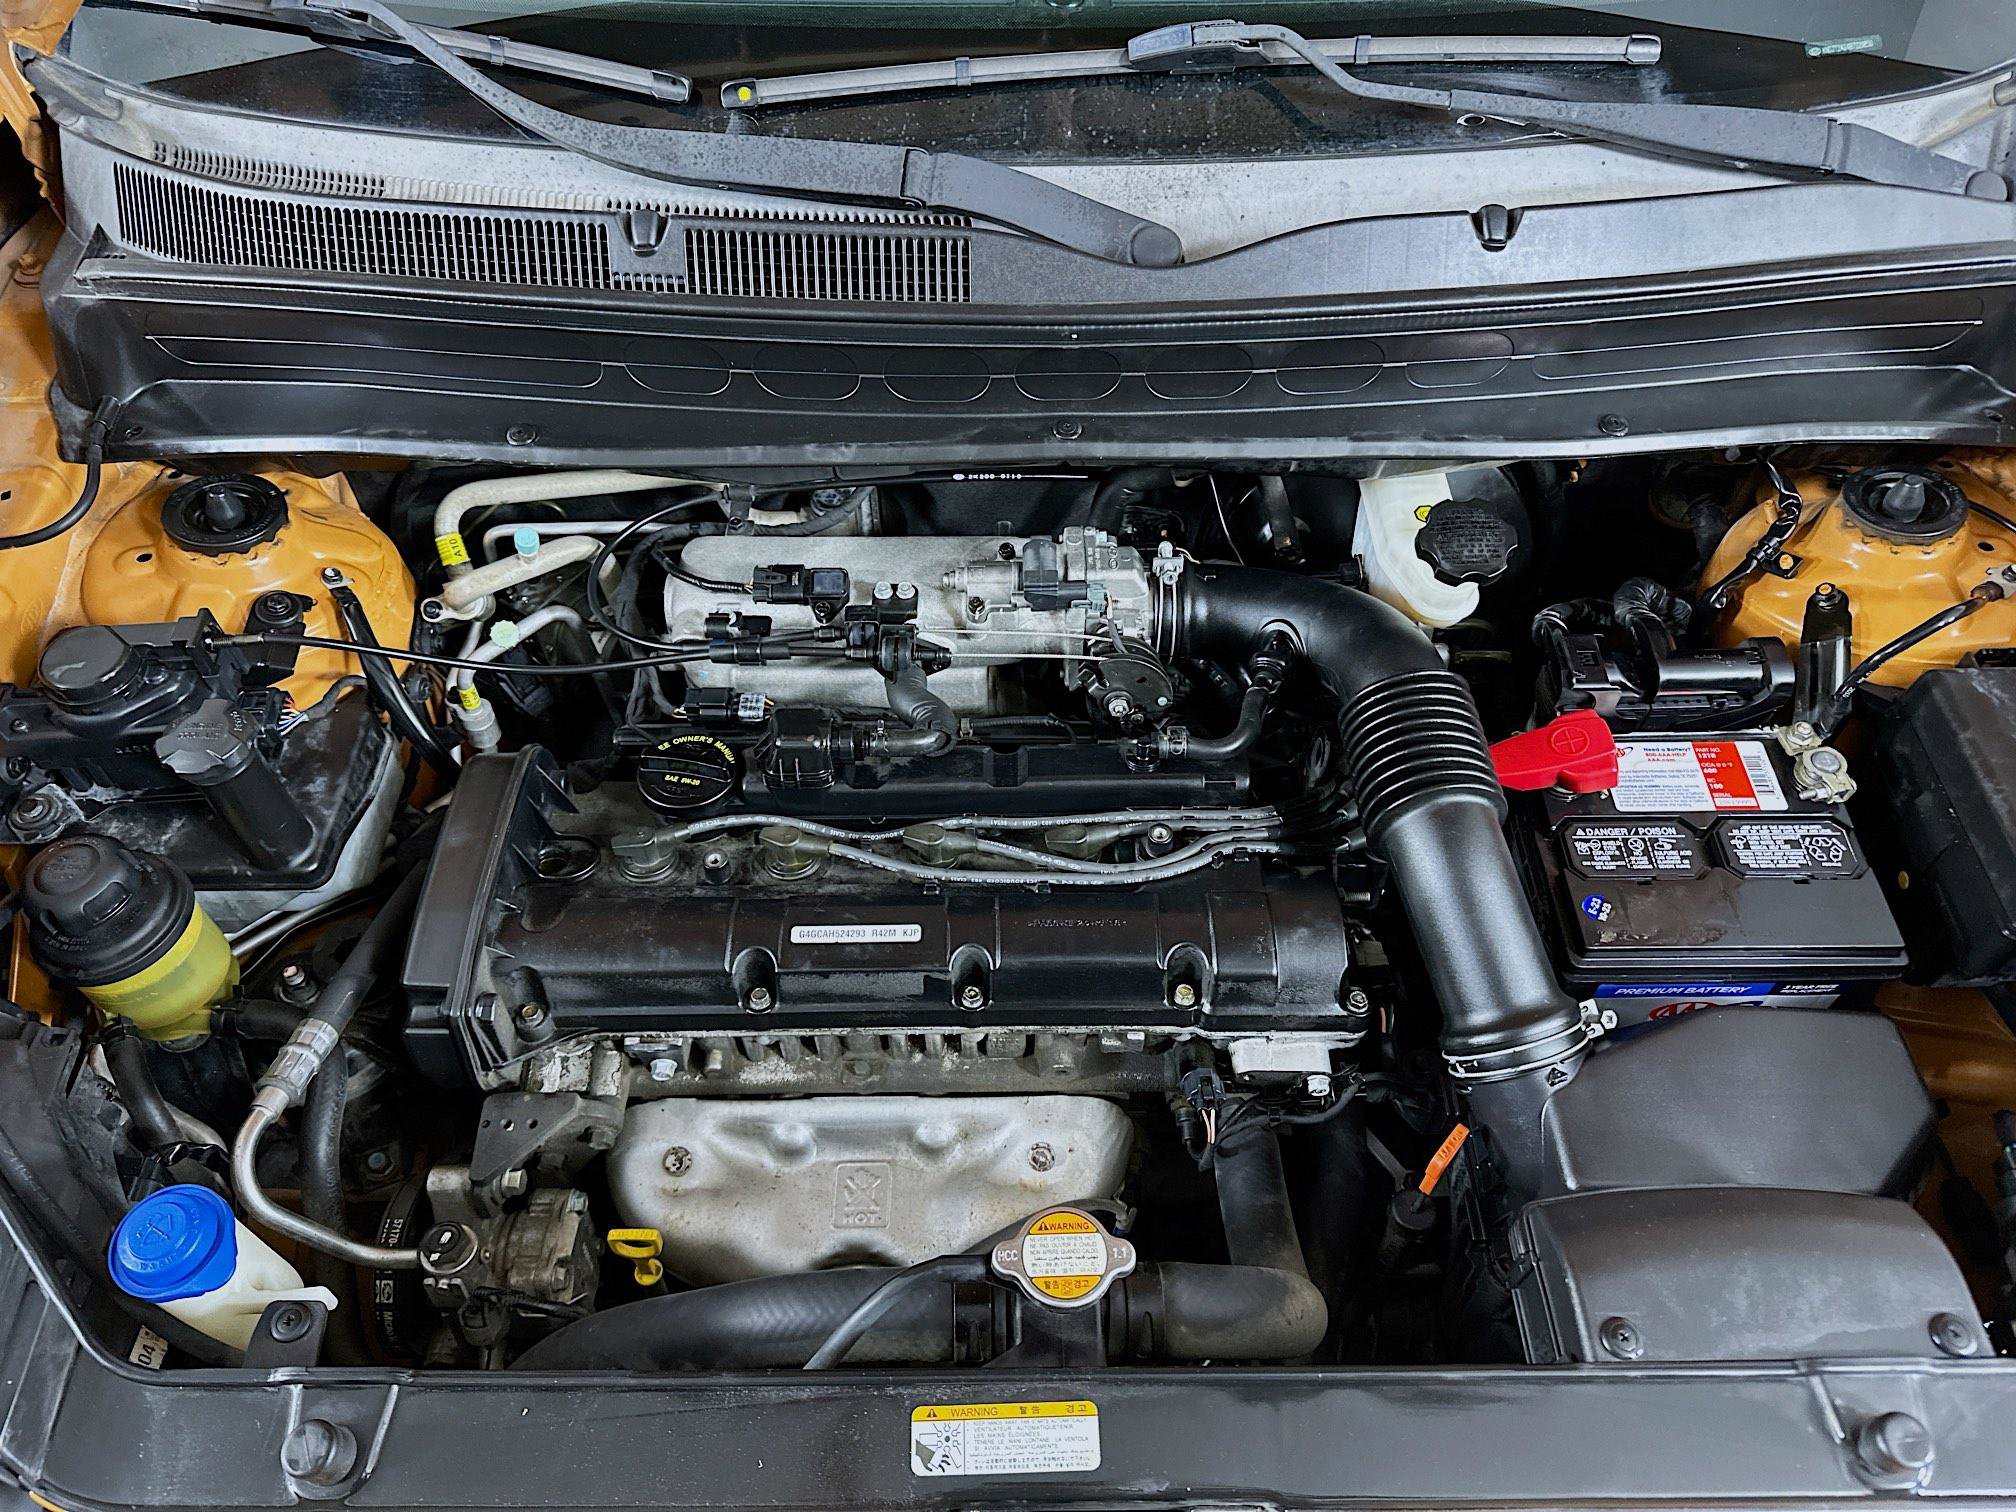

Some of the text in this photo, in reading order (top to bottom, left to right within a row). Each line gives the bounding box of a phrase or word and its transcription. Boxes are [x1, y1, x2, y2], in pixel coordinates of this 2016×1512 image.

[450, 538, 462, 557] A10
[672, 736, 713, 744] OWNER'S
[664, 774, 679, 782] SAE
[1586, 828, 1628, 836] DANGER
[1638, 827, 1676, 835] POISON
[1688, 986, 1751, 994] BATTERY
[1048, 1222, 1089, 1231] WARNING
[998, 1250, 1018, 1261] HCC
[1074, 1280, 1089, 1288] 경고
[950, 1406, 998, 1416] WARNING
